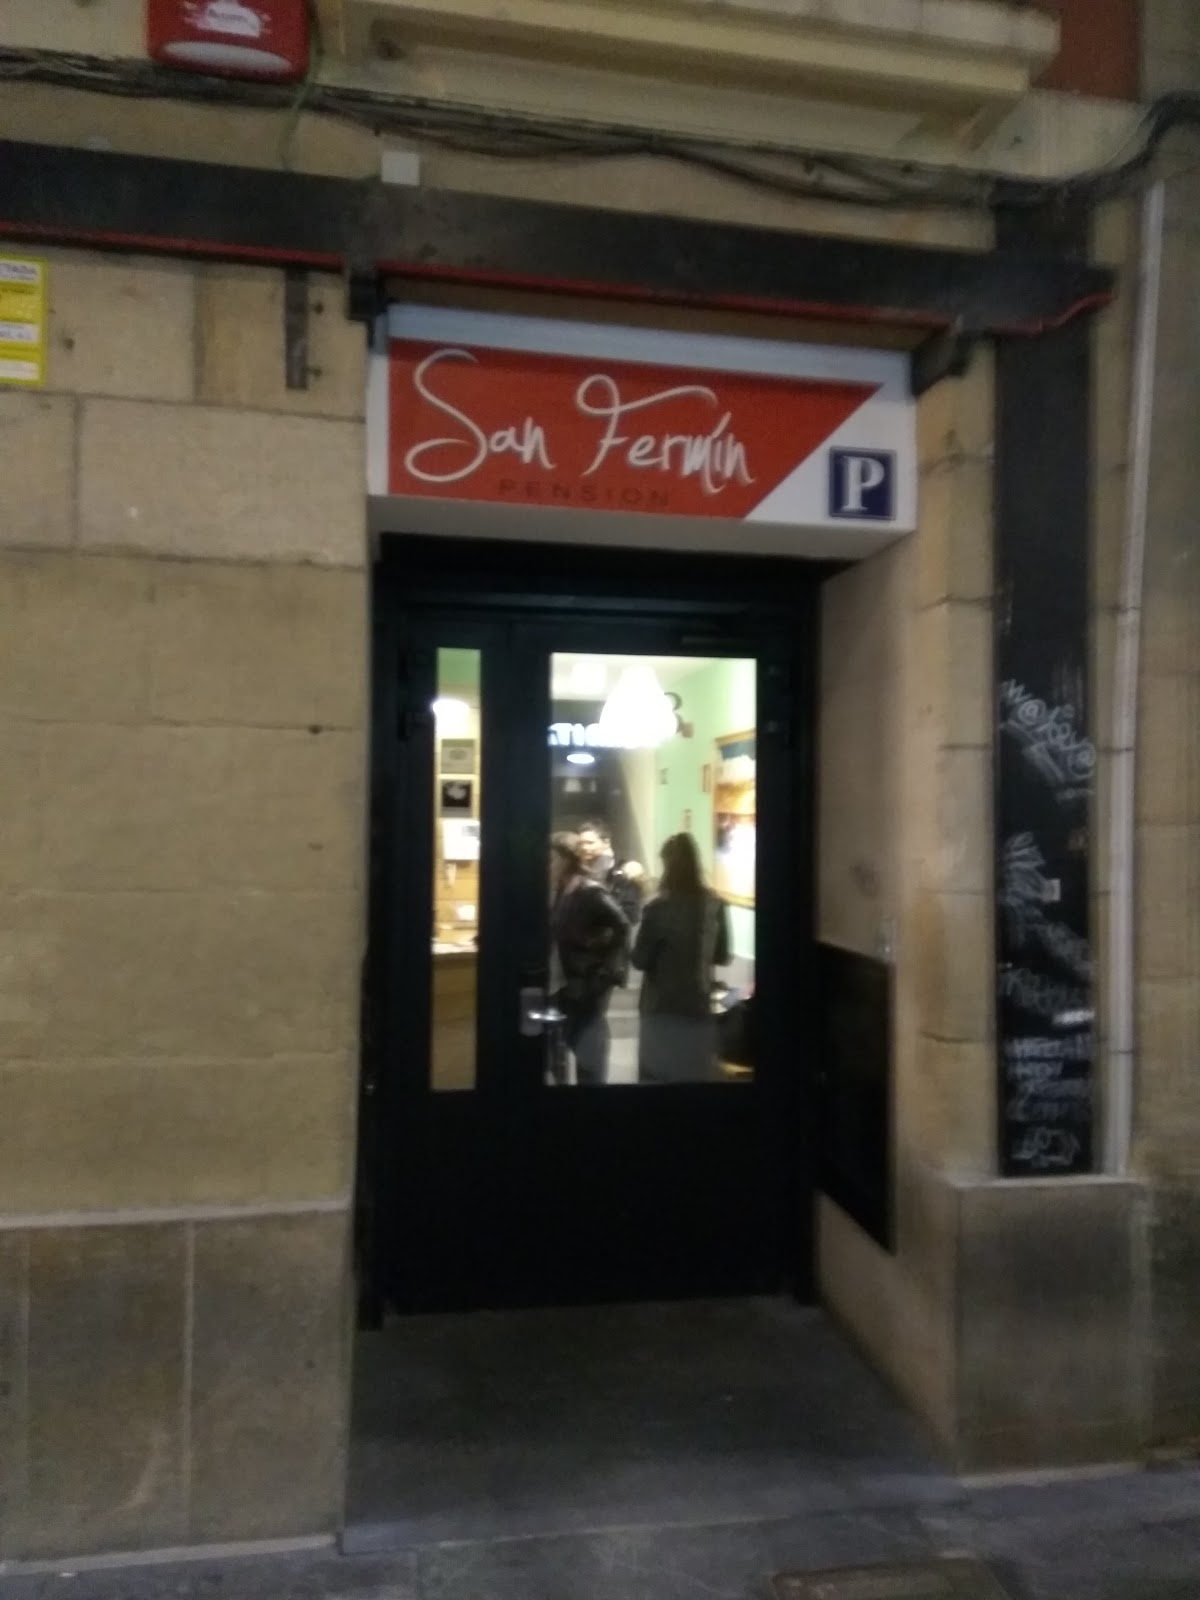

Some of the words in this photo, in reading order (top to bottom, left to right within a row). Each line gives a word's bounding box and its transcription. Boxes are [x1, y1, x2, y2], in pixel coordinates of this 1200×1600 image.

[404, 347, 557, 483] San
[497, 478, 669, 507] PENSION
[841, 454, 886, 512] P
